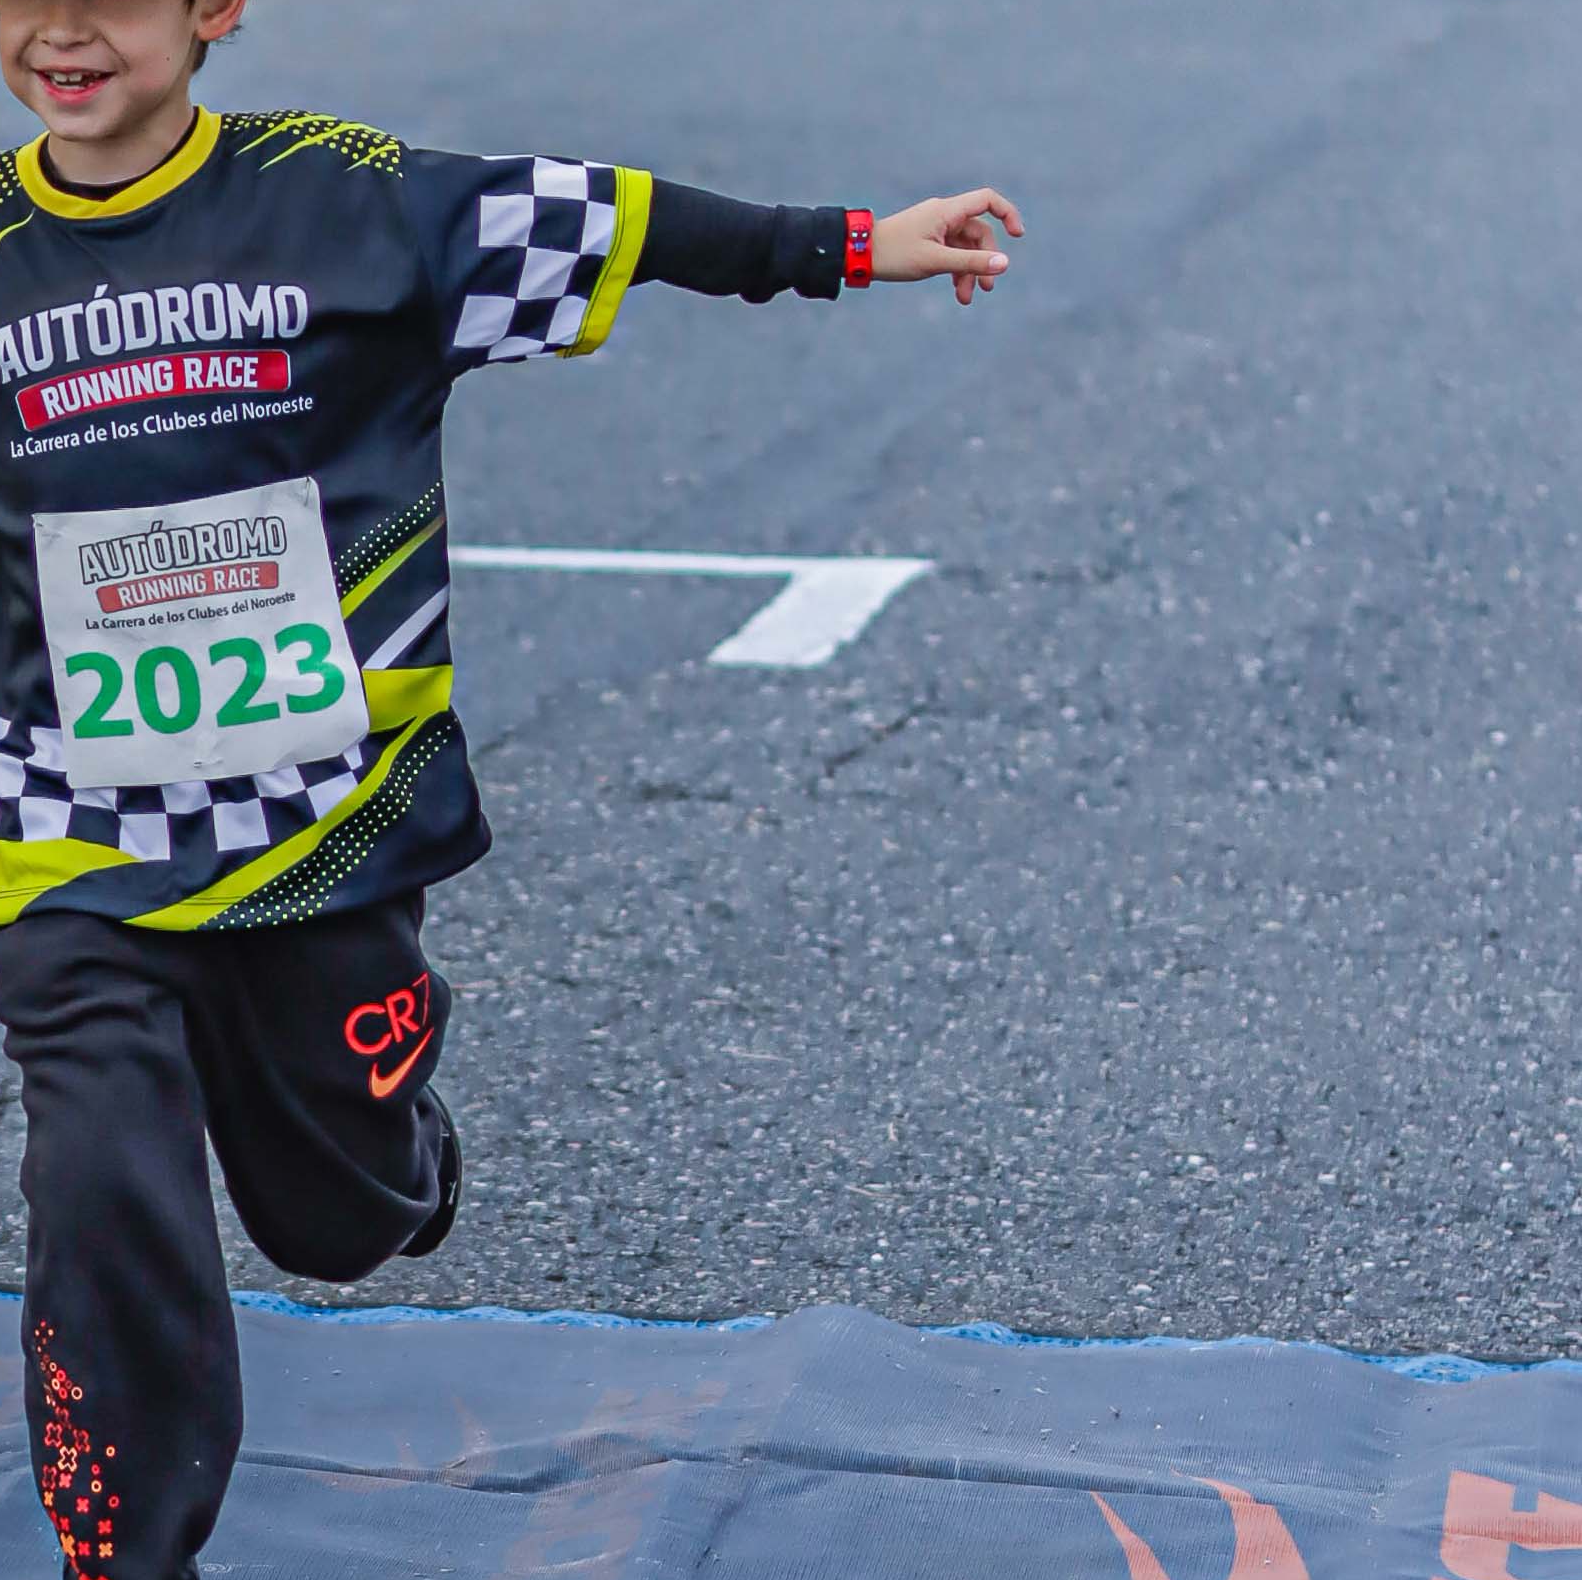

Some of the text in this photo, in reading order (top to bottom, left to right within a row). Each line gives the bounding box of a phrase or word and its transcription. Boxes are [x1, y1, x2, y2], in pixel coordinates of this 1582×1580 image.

[39, 356, 259, 421] RUNNING RACE
[9, 395, 315, 459] La Carrera de los Clubes del Noroeste
[78, 516, 288, 585] AUTÓDROMO
[85, 591, 297, 630] La Carrera de los Clubes del Noroeste
[117, 566, 262, 608] RUNNING RACE
[65, 623, 346, 739] 2023
[344, 972, 430, 1055] CR7
